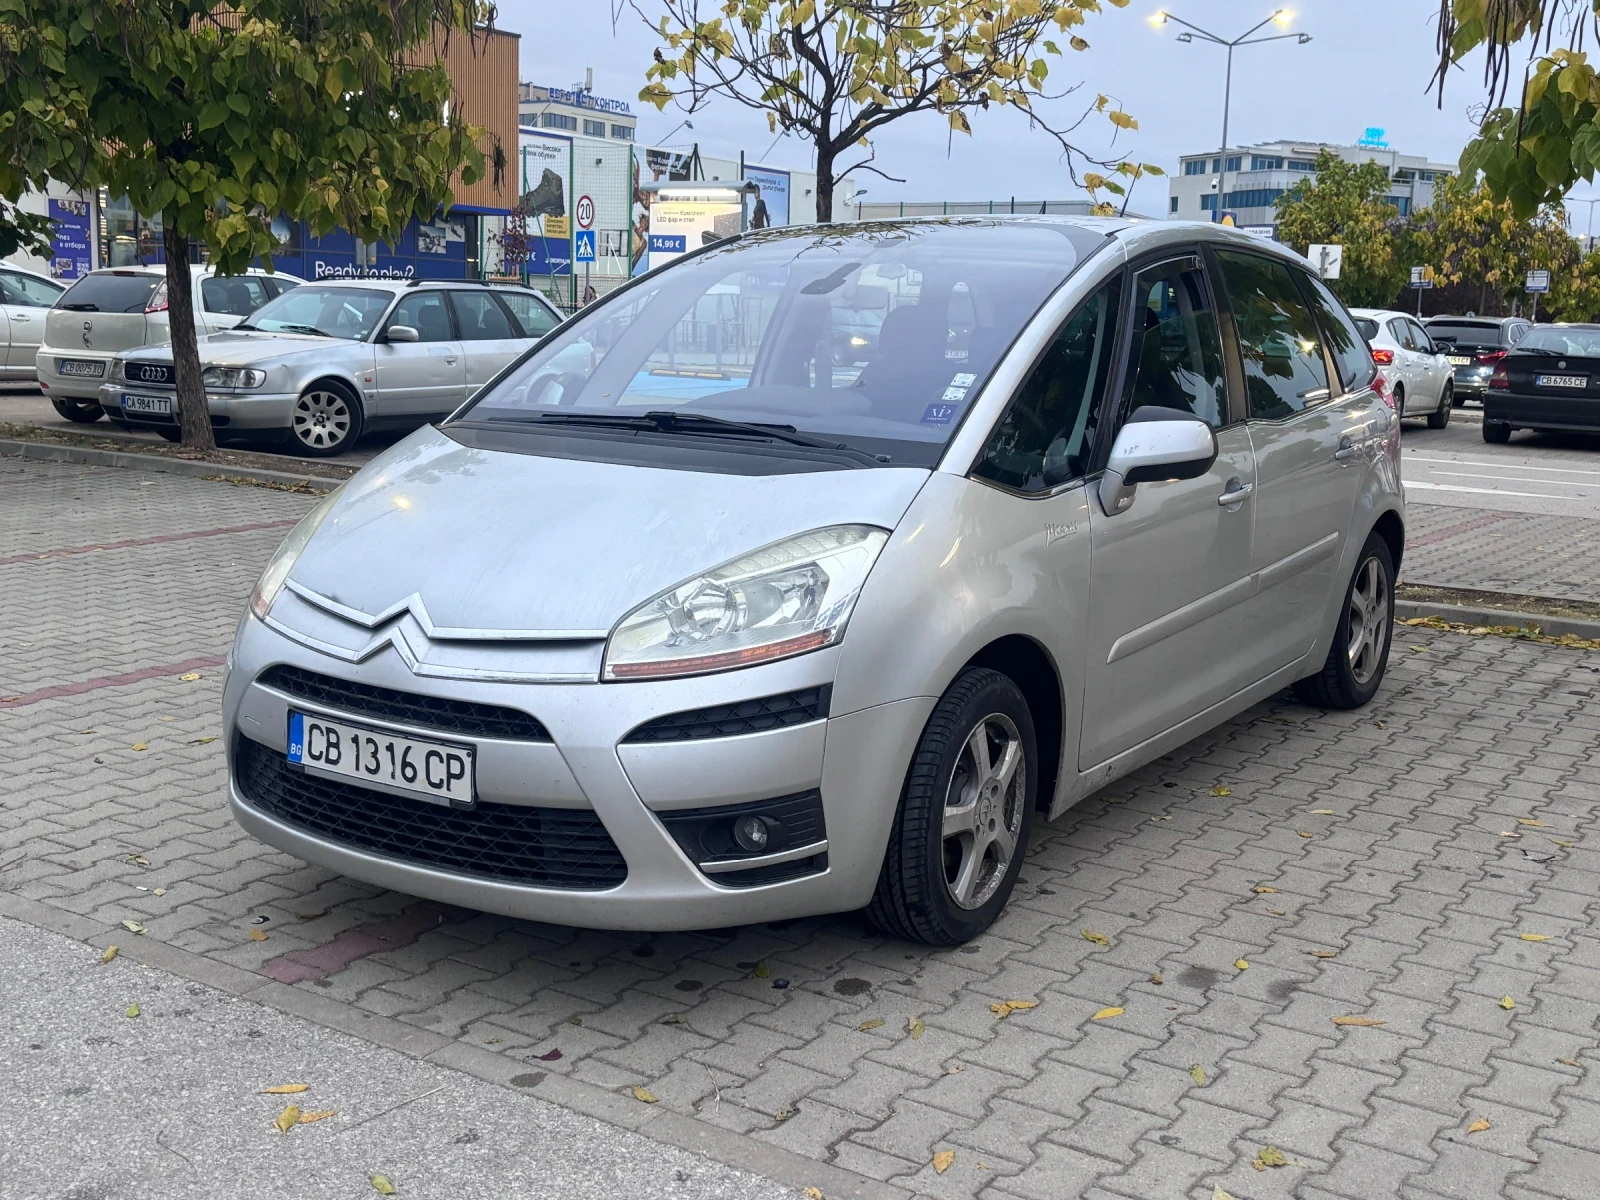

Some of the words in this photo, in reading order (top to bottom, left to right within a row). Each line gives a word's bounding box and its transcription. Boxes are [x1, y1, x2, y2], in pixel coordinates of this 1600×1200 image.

[594, 97, 630, 113] КОНТРОЛ
[580, 204, 591, 220] 20
[64, 242, 86, 250] отбора
[653, 238, 674, 249] 14,99
[675, 240, 681, 248] €
[315, 261, 361, 281] Ready
[380, 265, 415, 281] play?
[1541, 376, 1552, 385] CB
[1553, 377, 1573, 386] 6765
[1573, 378, 1585, 387] CE
[126, 397, 136, 409] CA
[137, 397, 155, 411] 9841
[157, 400, 170, 412] TT
[290, 742, 302, 756] BG
[307, 723, 342, 765] CB
[351, 733, 418, 784] 1316
[424, 750, 466, 791] CP
